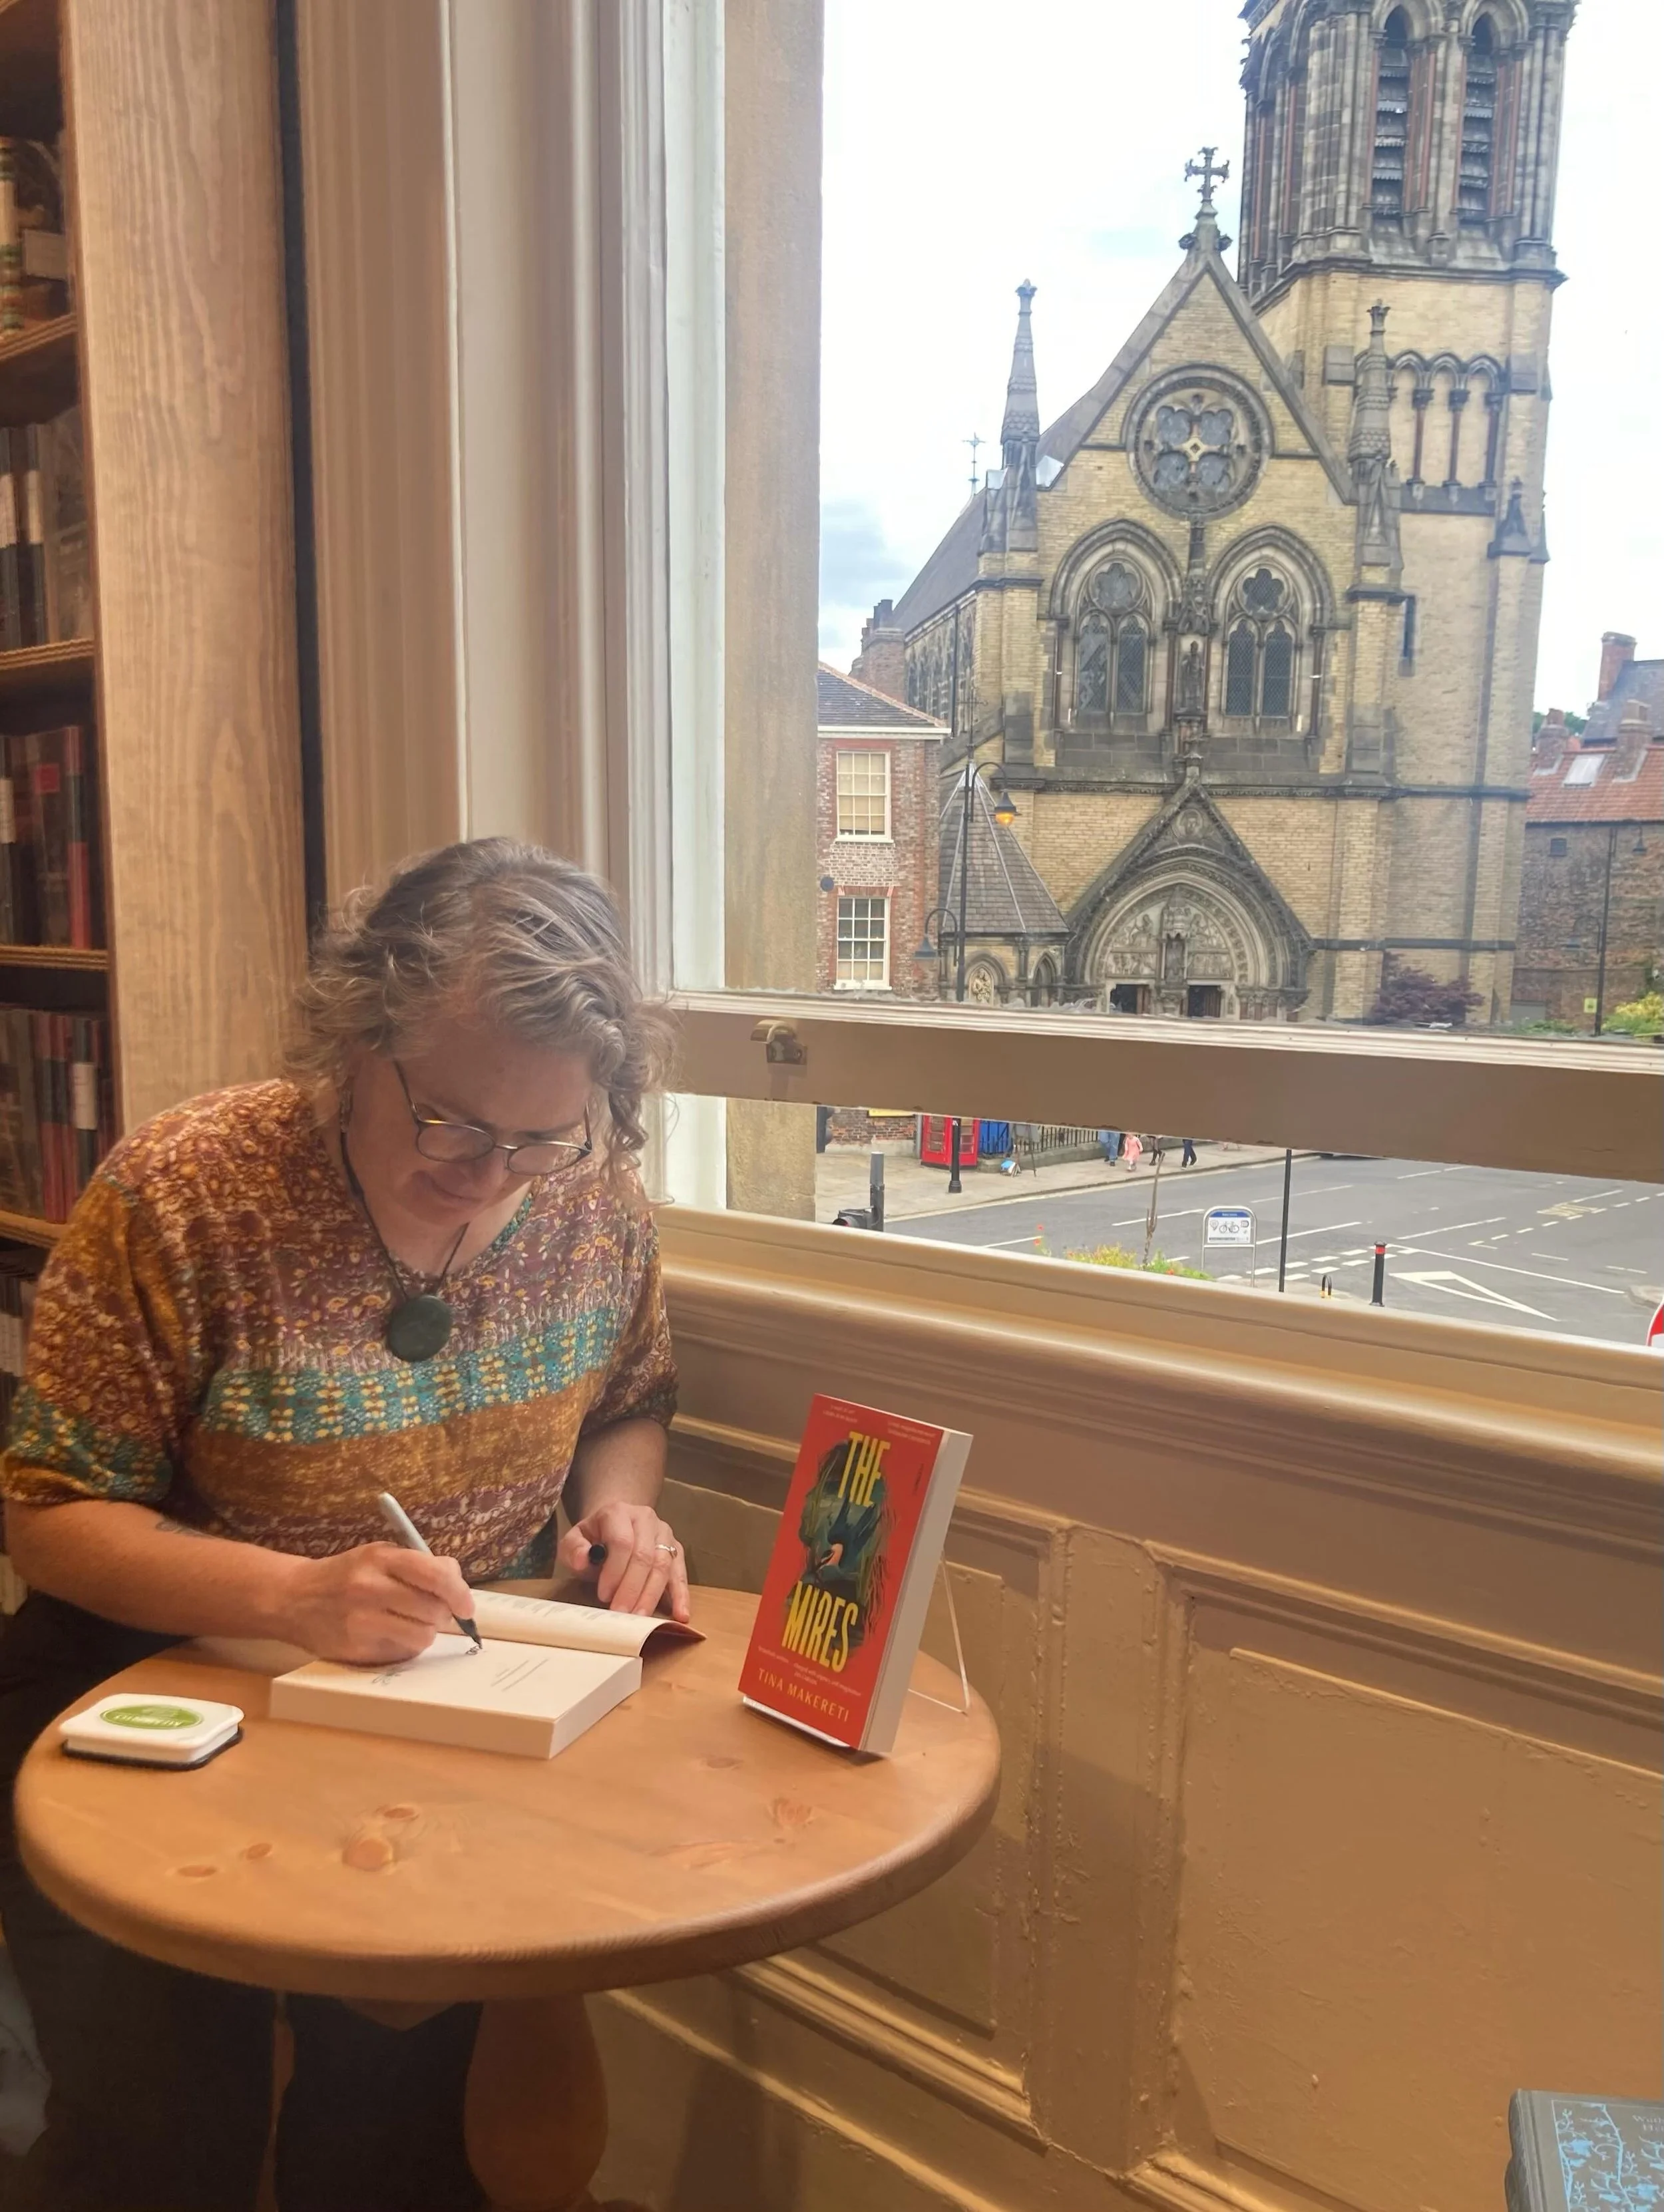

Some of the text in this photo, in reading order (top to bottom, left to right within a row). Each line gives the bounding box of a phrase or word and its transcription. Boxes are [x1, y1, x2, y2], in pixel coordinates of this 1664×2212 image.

[838, 1431, 890, 1507] THE
[782, 1581, 859, 1672] MIRES
[758, 1668, 783, 1691] TINA
[787, 1683, 849, 1722] MAKERETI
